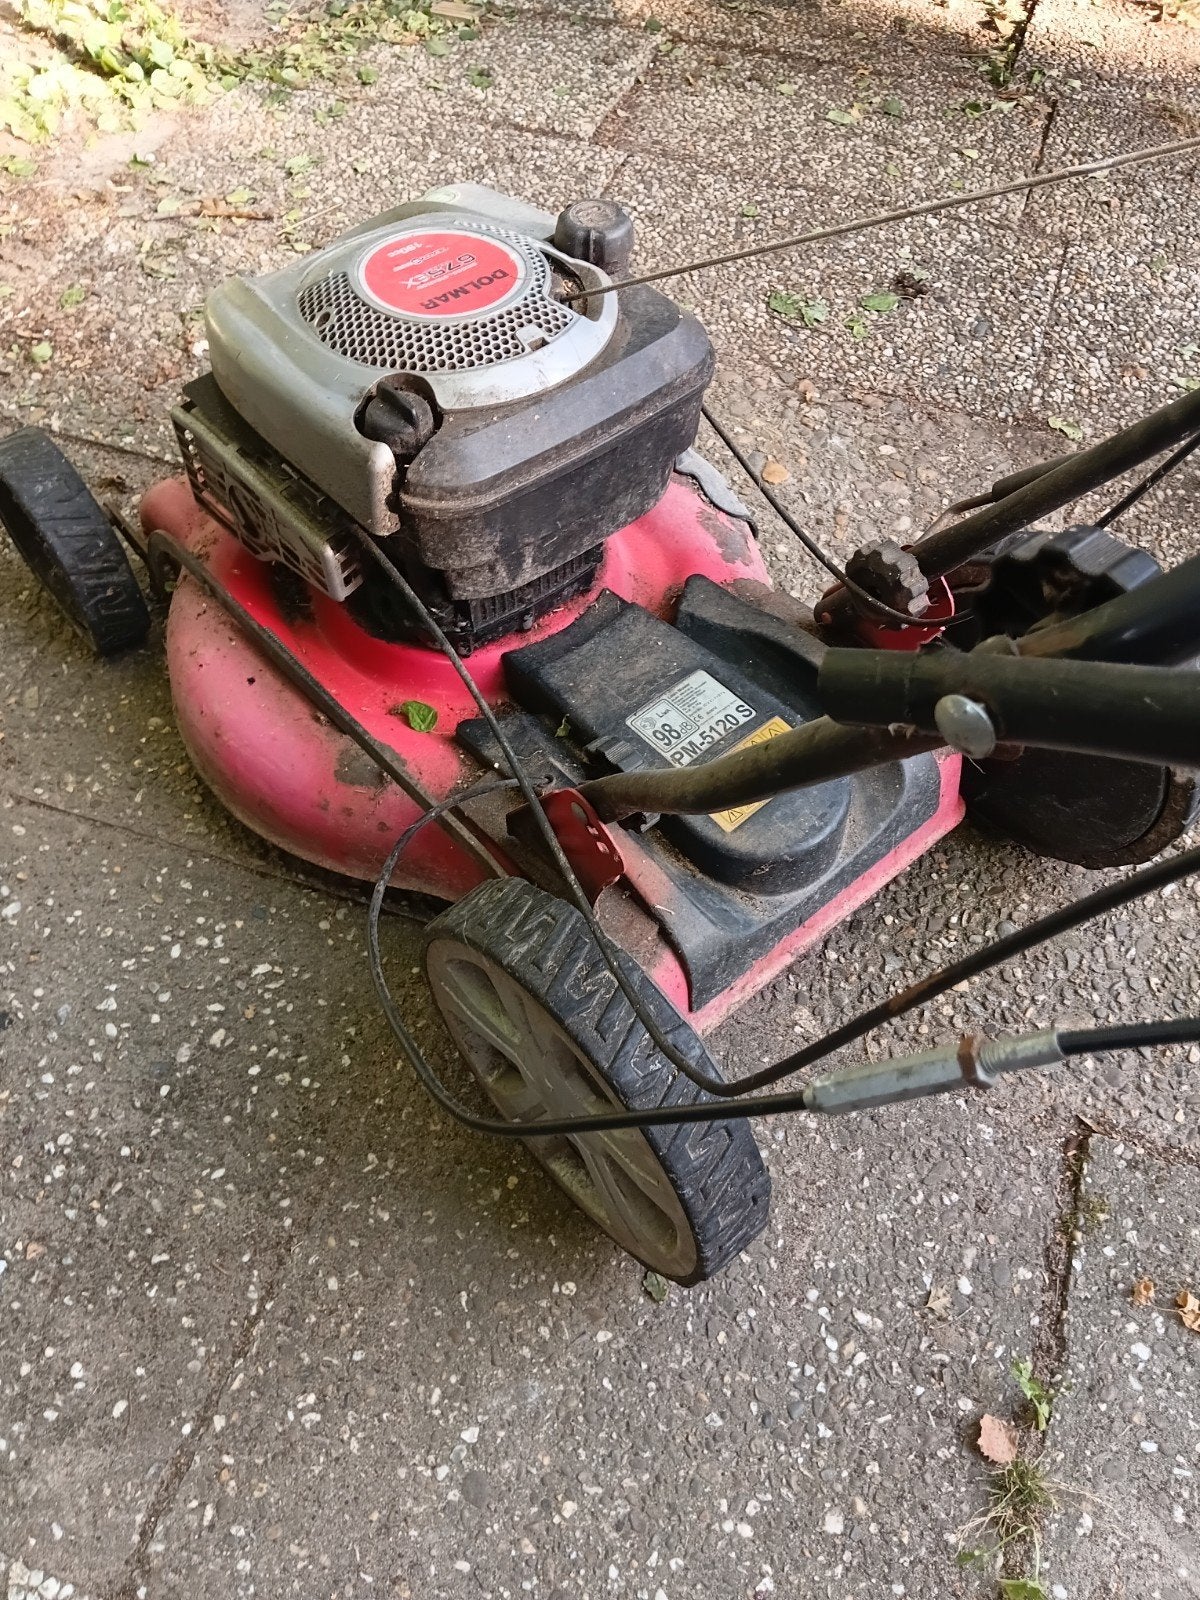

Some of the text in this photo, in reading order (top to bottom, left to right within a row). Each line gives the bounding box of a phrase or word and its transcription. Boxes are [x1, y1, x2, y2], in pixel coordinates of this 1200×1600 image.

[419, 268, 510, 310] DOLMAR
[652, 722, 682, 747] 98
[669, 713, 741, 767] PM-5120
[735, 704, 754, 718] S
